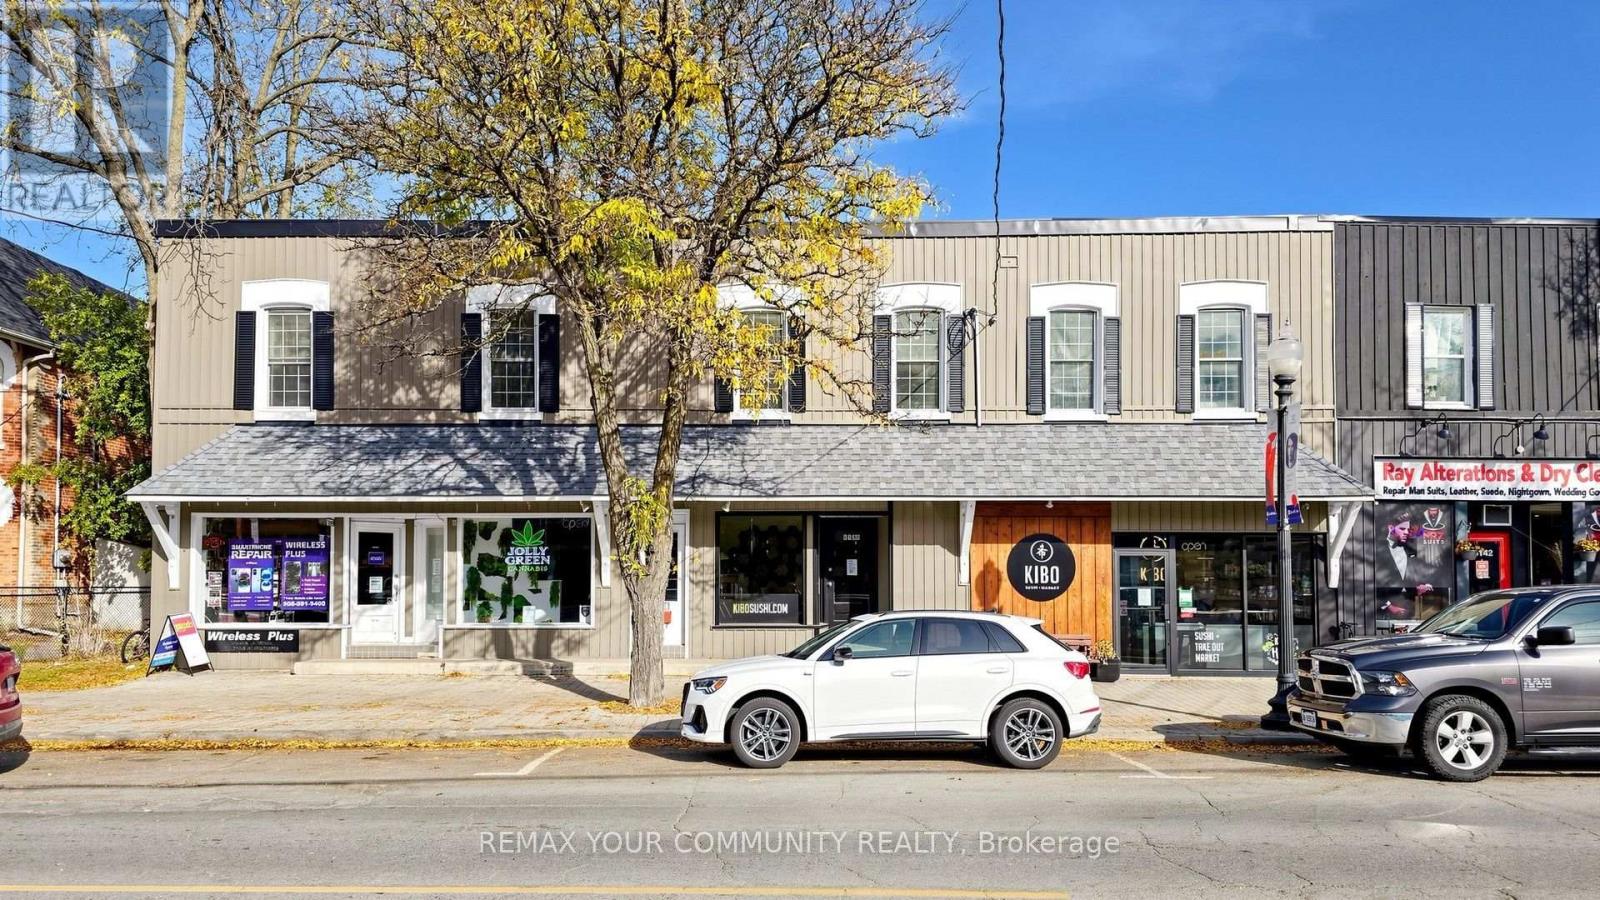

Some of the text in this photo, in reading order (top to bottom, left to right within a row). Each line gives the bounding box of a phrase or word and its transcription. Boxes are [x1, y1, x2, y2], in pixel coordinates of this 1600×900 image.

[1383, 462, 1414, 486] Ray
[1420, 462, 1515, 483] Alterations
[1521, 463, 1535, 482] &
[1540, 463, 1571, 486] Dry
[1383, 487, 1407, 496] Repair
[1409, 487, 1425, 495] Man
[1427, 487, 1448, 496] Suits,
[1450, 487, 1479, 497] Leather,
[1481, 488, 1506, 496] Suede,
[1554, 488, 1587, 498] Wedding
[285, 541, 326, 549] WIRELESS
[231, 550, 272, 559] REPAIR
[285, 550, 306, 558] PLUS
[507, 546, 549, 556] JOLLY
[504, 556, 551, 565] GREEN
[1024, 565, 1060, 584] KIBO
[732, 603, 789, 614] KIBOSUSHI.COM
[207, 631, 294, 641] Wireless Plus
[1194, 631, 1214, 641] SUSHI
[1195, 642, 1224, 652] TAKE OUT
[1195, 653, 1220, 663] MARKET
